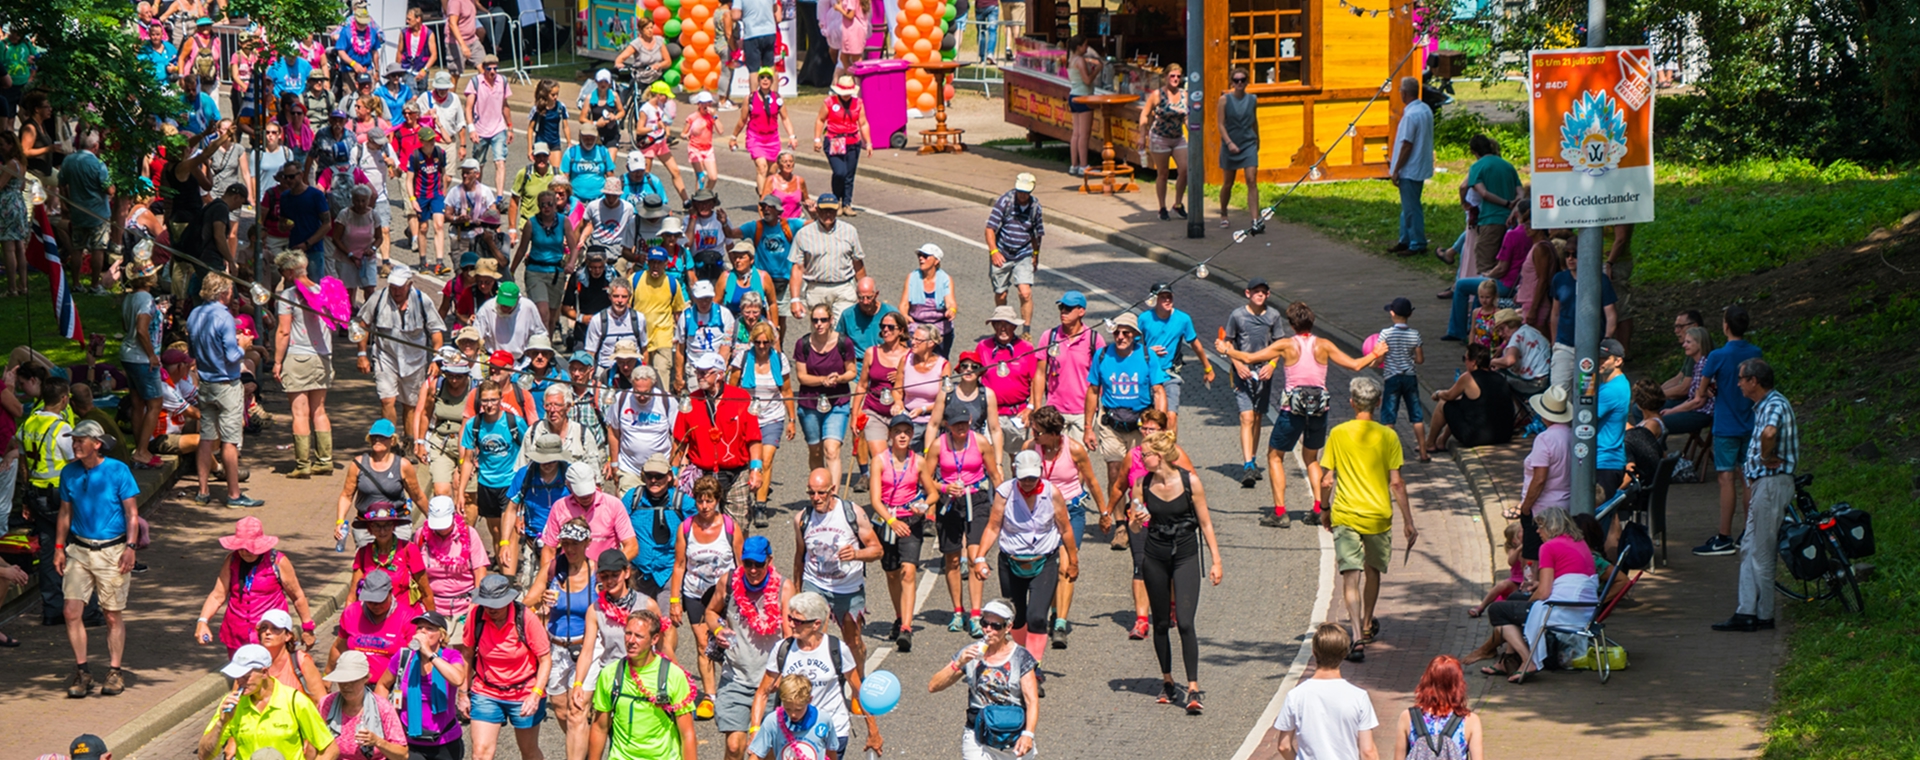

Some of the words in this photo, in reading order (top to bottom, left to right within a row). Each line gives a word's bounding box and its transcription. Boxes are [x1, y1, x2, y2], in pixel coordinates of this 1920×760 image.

[1535, 59, 1544, 67] 15
[1545, 58, 1561, 66] t/m
[1562, 57, 1571, 66] 21
[1571, 57, 1586, 67] juli
[1587, 56, 1606, 65] 2017
[1545, 81, 1568, 89] #4DF
[1557, 196, 1571, 207] de
[1572, 192, 1640, 206] Gelderlander
[1109, 372, 1139, 395] 101
[786, 659, 803, 675] COTE
[807, 658, 830, 674] D'AZUR
